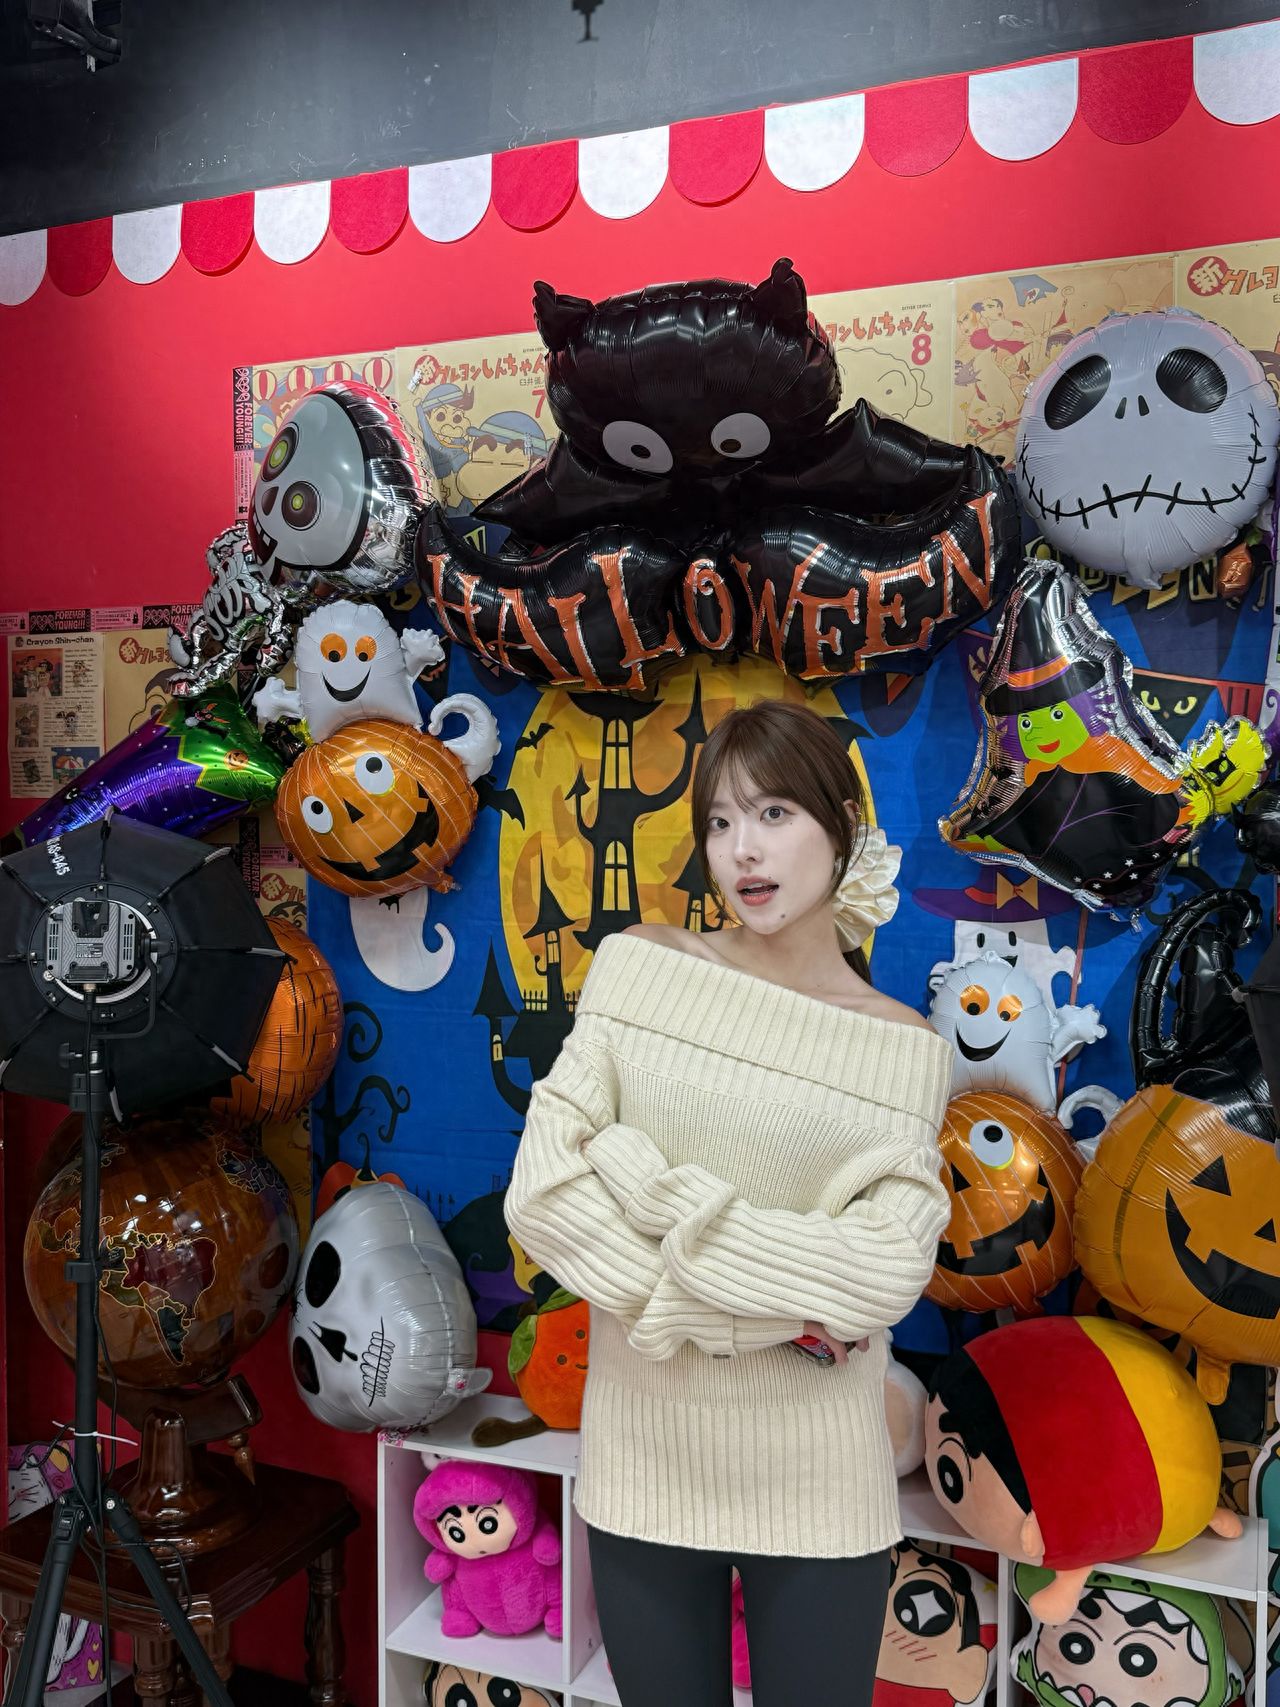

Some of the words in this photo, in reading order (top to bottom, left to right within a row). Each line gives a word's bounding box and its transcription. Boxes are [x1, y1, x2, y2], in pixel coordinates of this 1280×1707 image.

[911, 333, 932, 366] 8
[532, 388, 545, 419] 7
[235, 402, 244, 444] YOUNG!!!
[244, 402, 253, 444] FOREVER
[426, 492, 998, 692] HALLOWEEN
[54, 609, 86, 620] FOREVER
[54, 619, 86, 630] YOUNG!!!
[26, 638, 54, 647] Crayon
[54, 635, 95, 645] Shin-chan
[251, 852, 260, 893] FOREVER
